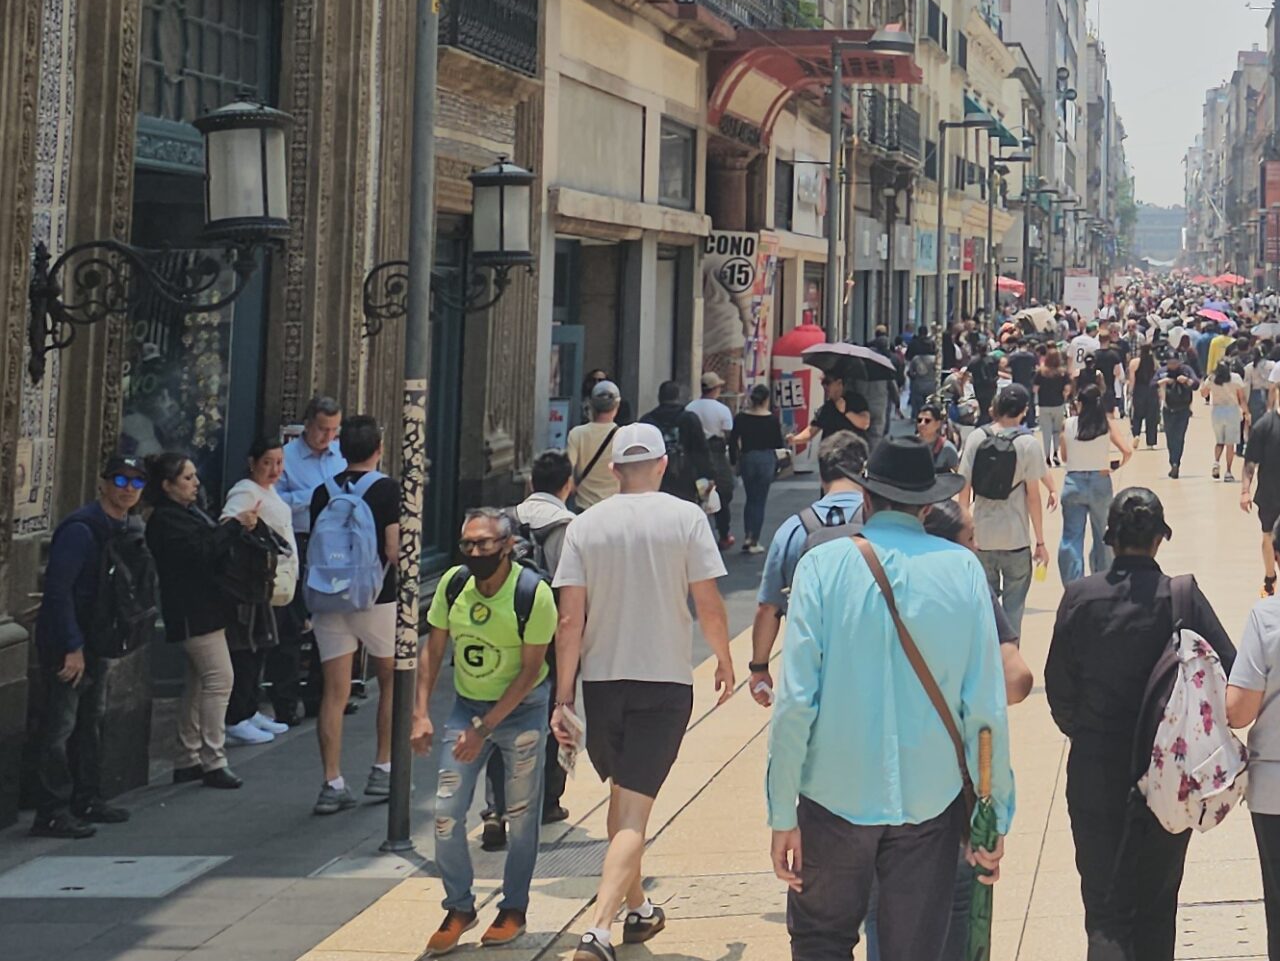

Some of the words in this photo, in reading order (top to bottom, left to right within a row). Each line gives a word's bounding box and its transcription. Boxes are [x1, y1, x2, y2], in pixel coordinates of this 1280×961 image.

[704, 234, 755, 257] CONO
[1076, 347, 1084, 363] 8
[464, 645, 484, 667] G
